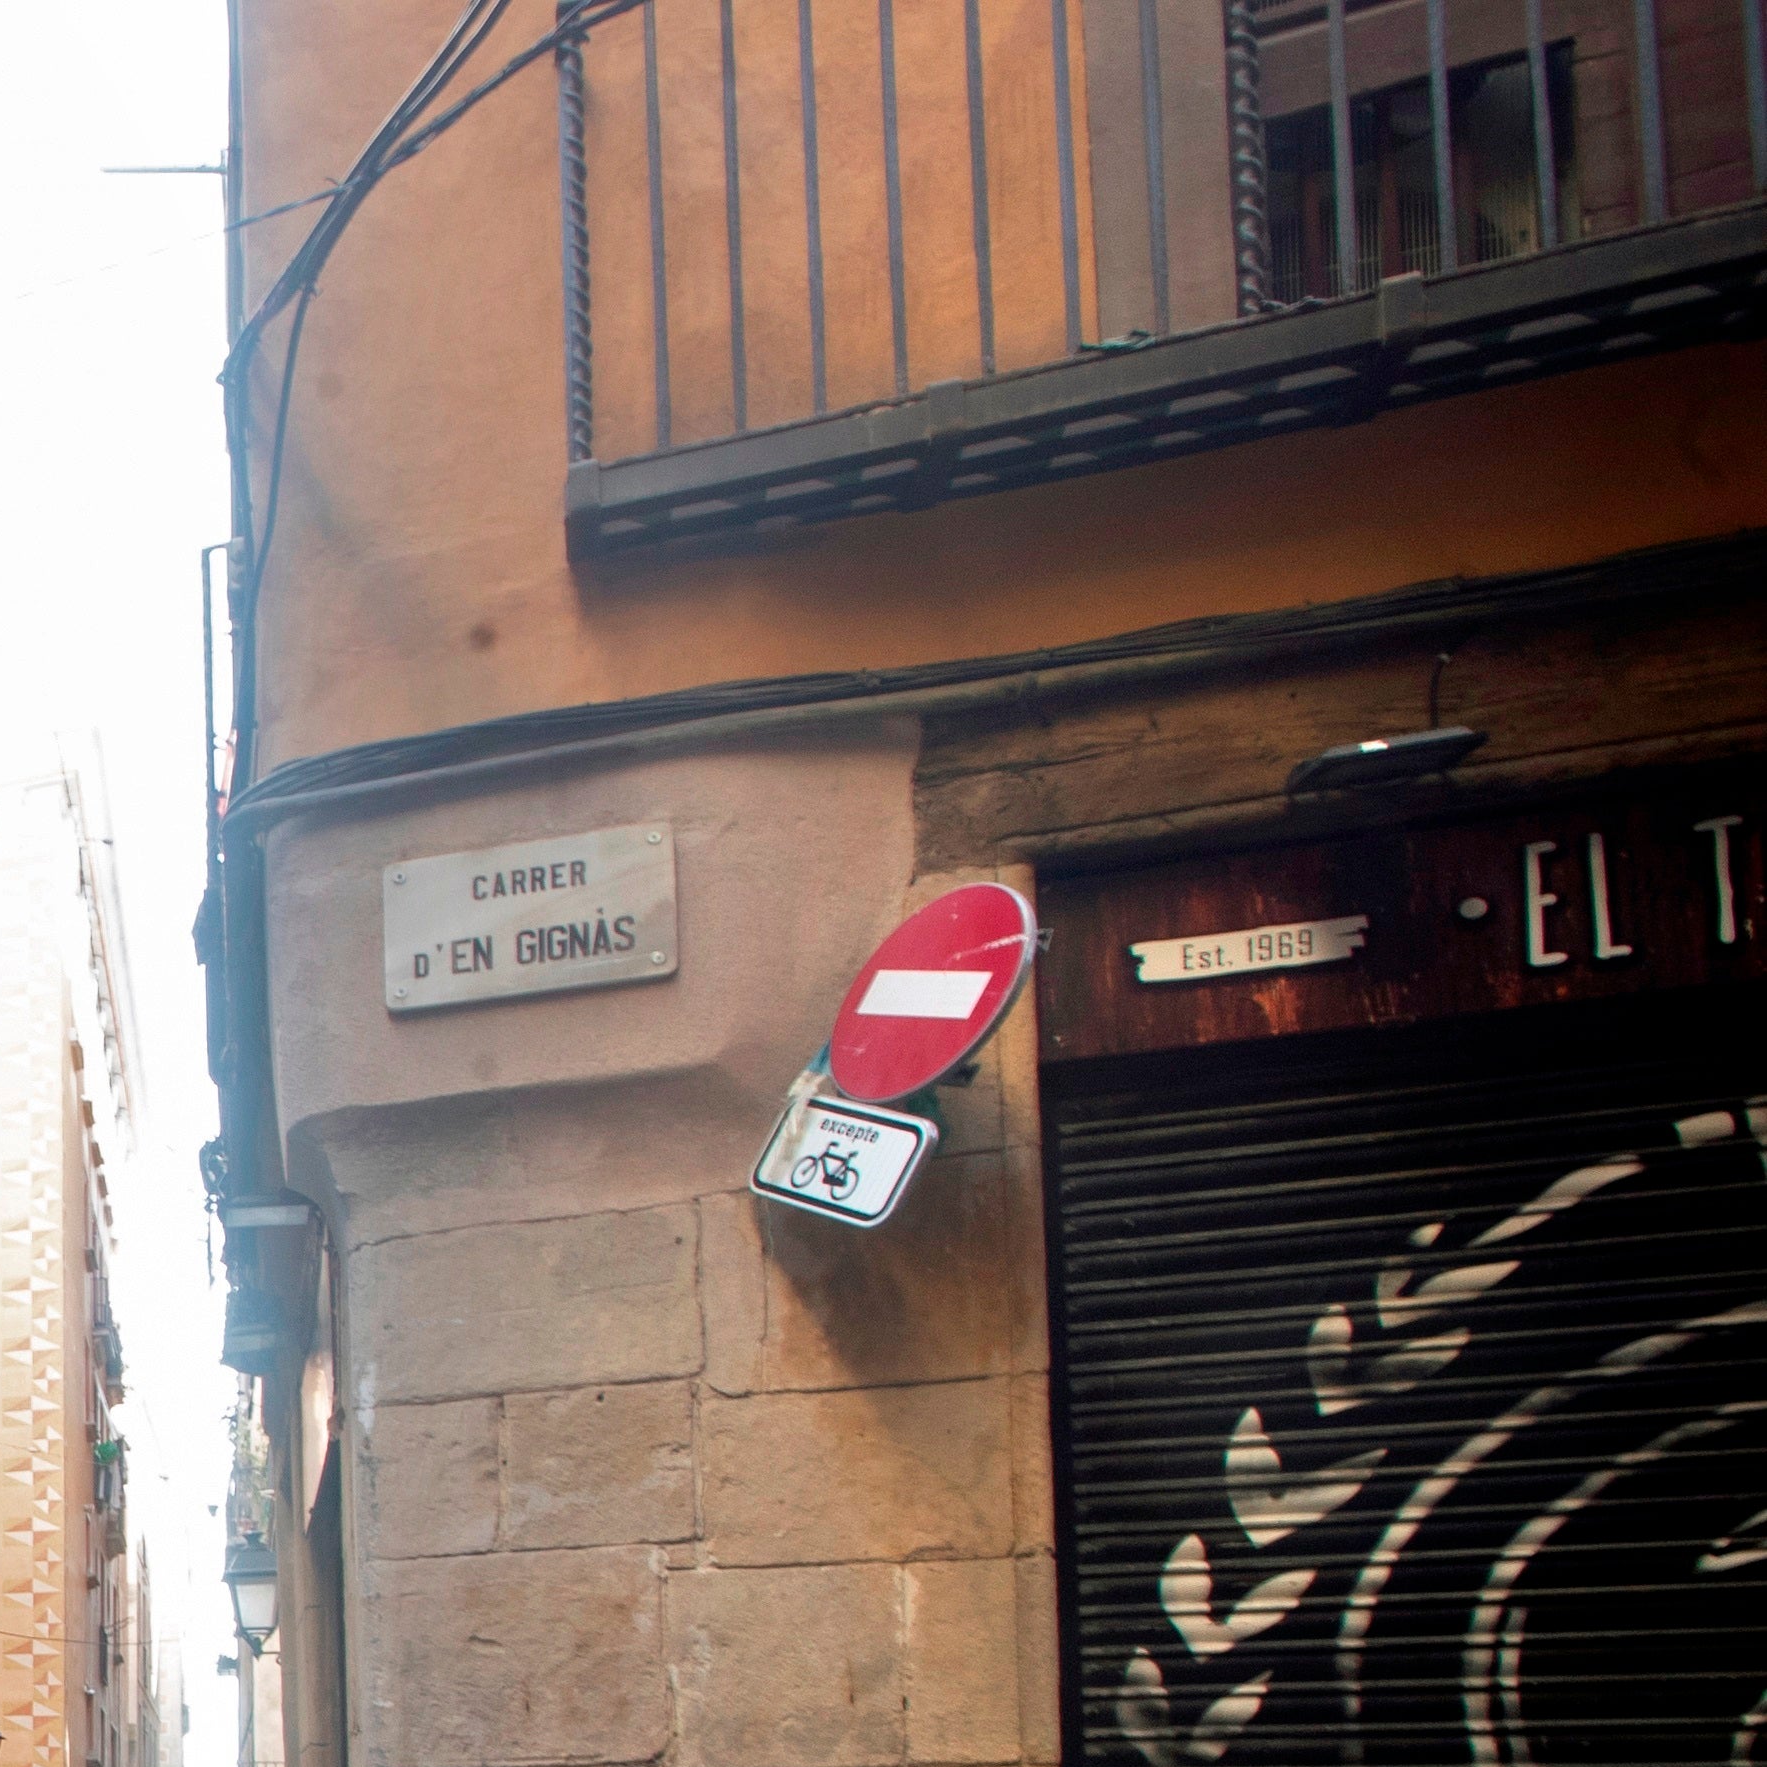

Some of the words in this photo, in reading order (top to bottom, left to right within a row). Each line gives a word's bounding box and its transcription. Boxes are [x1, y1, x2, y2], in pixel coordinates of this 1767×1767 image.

[472, 860, 587, 901] CARRER
[1525, 831, 1633, 968] EL
[414, 934, 494, 979] D'EN
[1181, 944, 1233, 971] Est.
[1247, 928, 1314, 963] 1969
[819, 1117, 881, 1144] excepte
